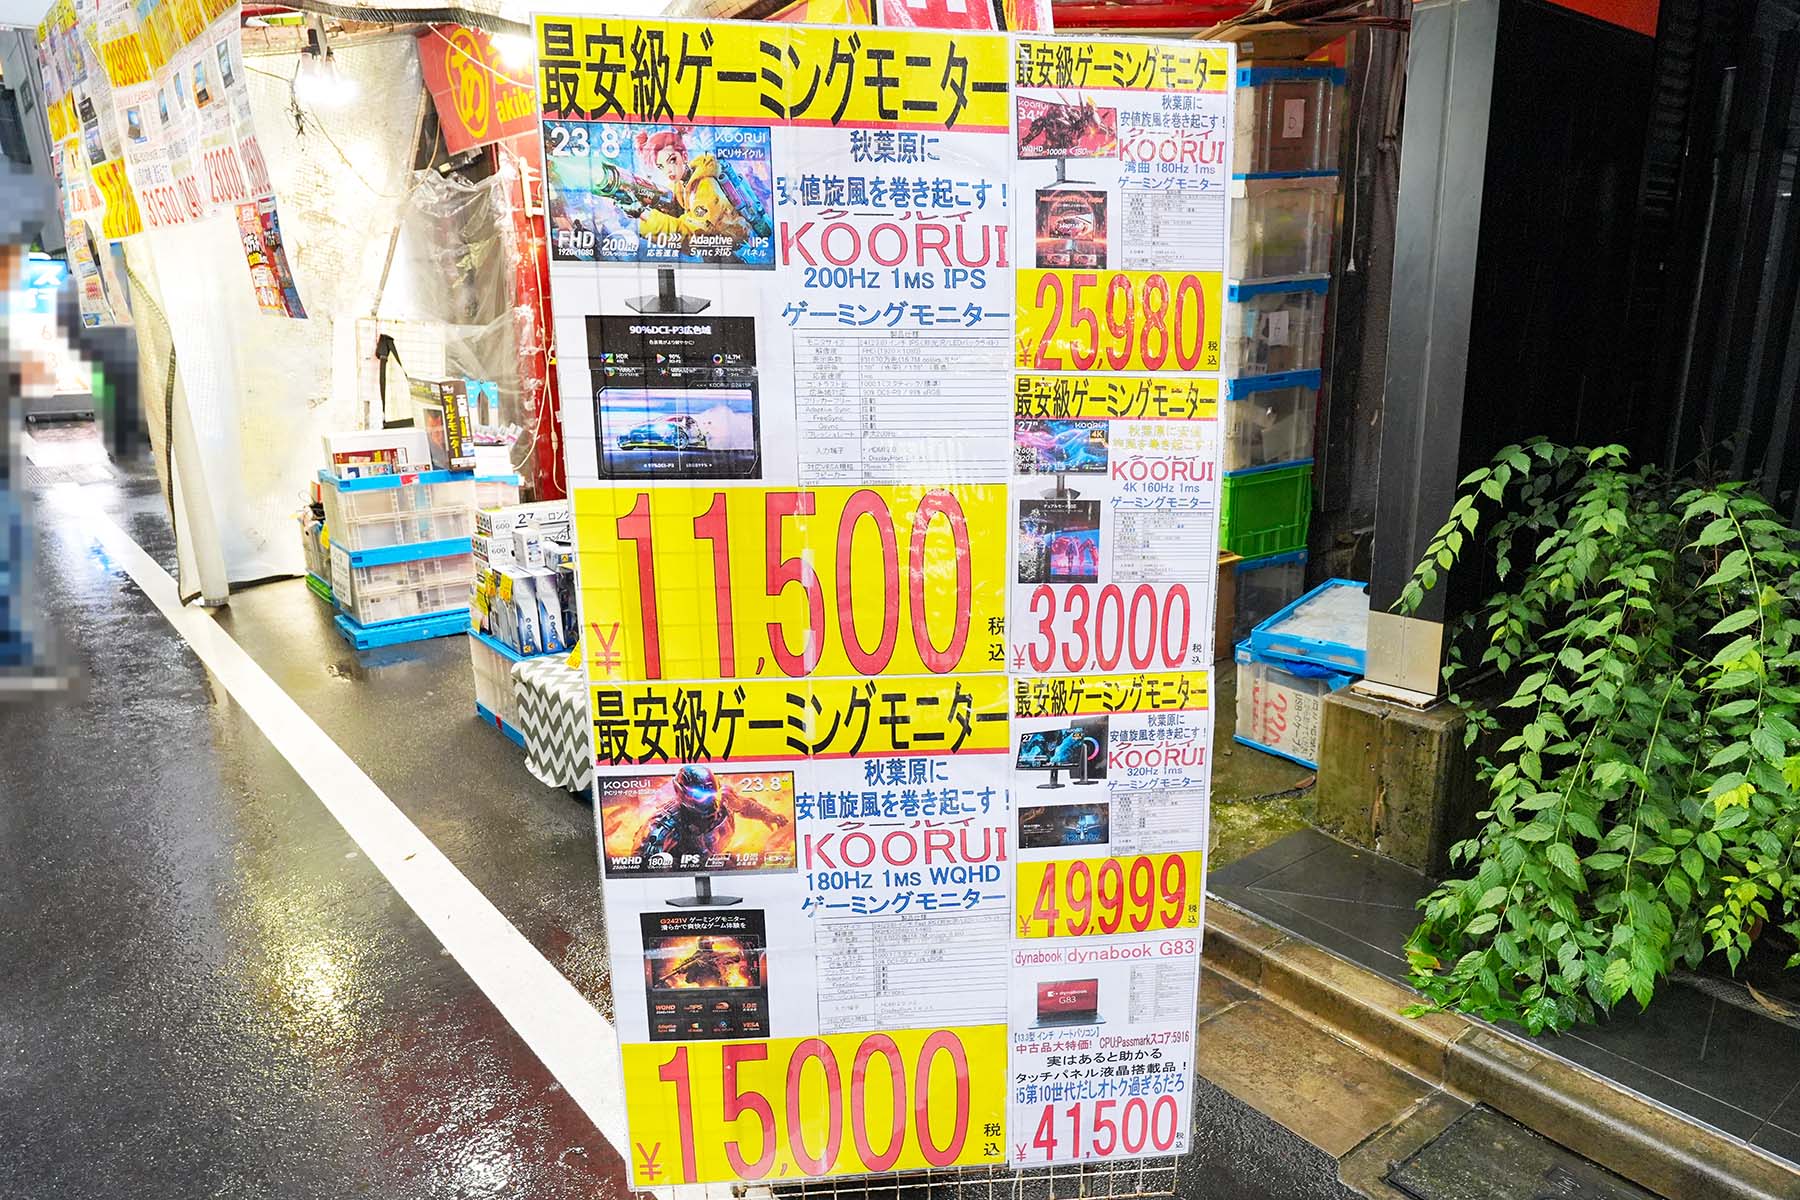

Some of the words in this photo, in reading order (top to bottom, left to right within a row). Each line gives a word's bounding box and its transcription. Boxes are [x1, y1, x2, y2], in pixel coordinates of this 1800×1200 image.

[539, 23, 1009, 130] 最安級ゲーミングモニター
[1016, 43, 1226, 91] 最安級ゲーミングモニター
[1161, 95, 1203, 111] 秋葉原に
[850, 131, 940, 163] 秋葉原に
[1119, 139, 1225, 164] KOORUI
[1125, 161, 1150, 174] 湾曲
[1156, 162, 1189, 175] 180Hz
[1118, 177, 1221, 190] ゲーミングモニター
[557, 231, 595, 249] FHD
[689, 235, 733, 246] Adaptive
[752, 237, 769, 248] IPS
[780, 222, 1009, 270] KOORUI
[944, 269, 986, 289] IPS
[781, 301, 1009, 328] ゲーミングモニター
[1207, 341, 1218, 366] 税込
[1015, 377, 1216, 419] 最安級ゲーミングモニター
[443, 395, 460, 458] マルチモニター
[1091, 430, 1103, 438] 4K
[1112, 461, 1214, 481] KOORUI
[1123, 483, 1137, 492] 4K
[1142, 483, 1174, 493] 160Hz
[1179, 483, 1200, 492] 1ms
[1110, 496, 1211, 509] ゲーミングモニター
[1015, 674, 1207, 717] 最安級ゲーミングモニター
[594, 680, 1009, 766] 最安級ゲーミングモニター
[1148, 713, 1185, 727] 秋葉原に
[1109, 748, 1205, 769] KOORUI
[864, 758, 948, 786] 秋葉原に
[1127, 767, 1158, 776] 320Hz
[603, 779, 651, 789] KOORUI
[1107, 777, 1202, 791] ゲーミングモニター
[681, 854, 700, 863] IPS
[804, 827, 1007, 870] KOORUI
[611, 856, 642, 865] WQHD
[930, 865, 1000, 885] WQHD
[801, 888, 1006, 917] ゲーミングモニター
[1015, 951, 1062, 966] dynabook
[1067, 944, 1152, 964] dynabook
[1160, 940, 1195, 956] G83
[1058, 996, 1077, 1004] G83
[1047, 1047, 1162, 1067] 実はあると助かる
[983, 1123, 1001, 1157] 税込
